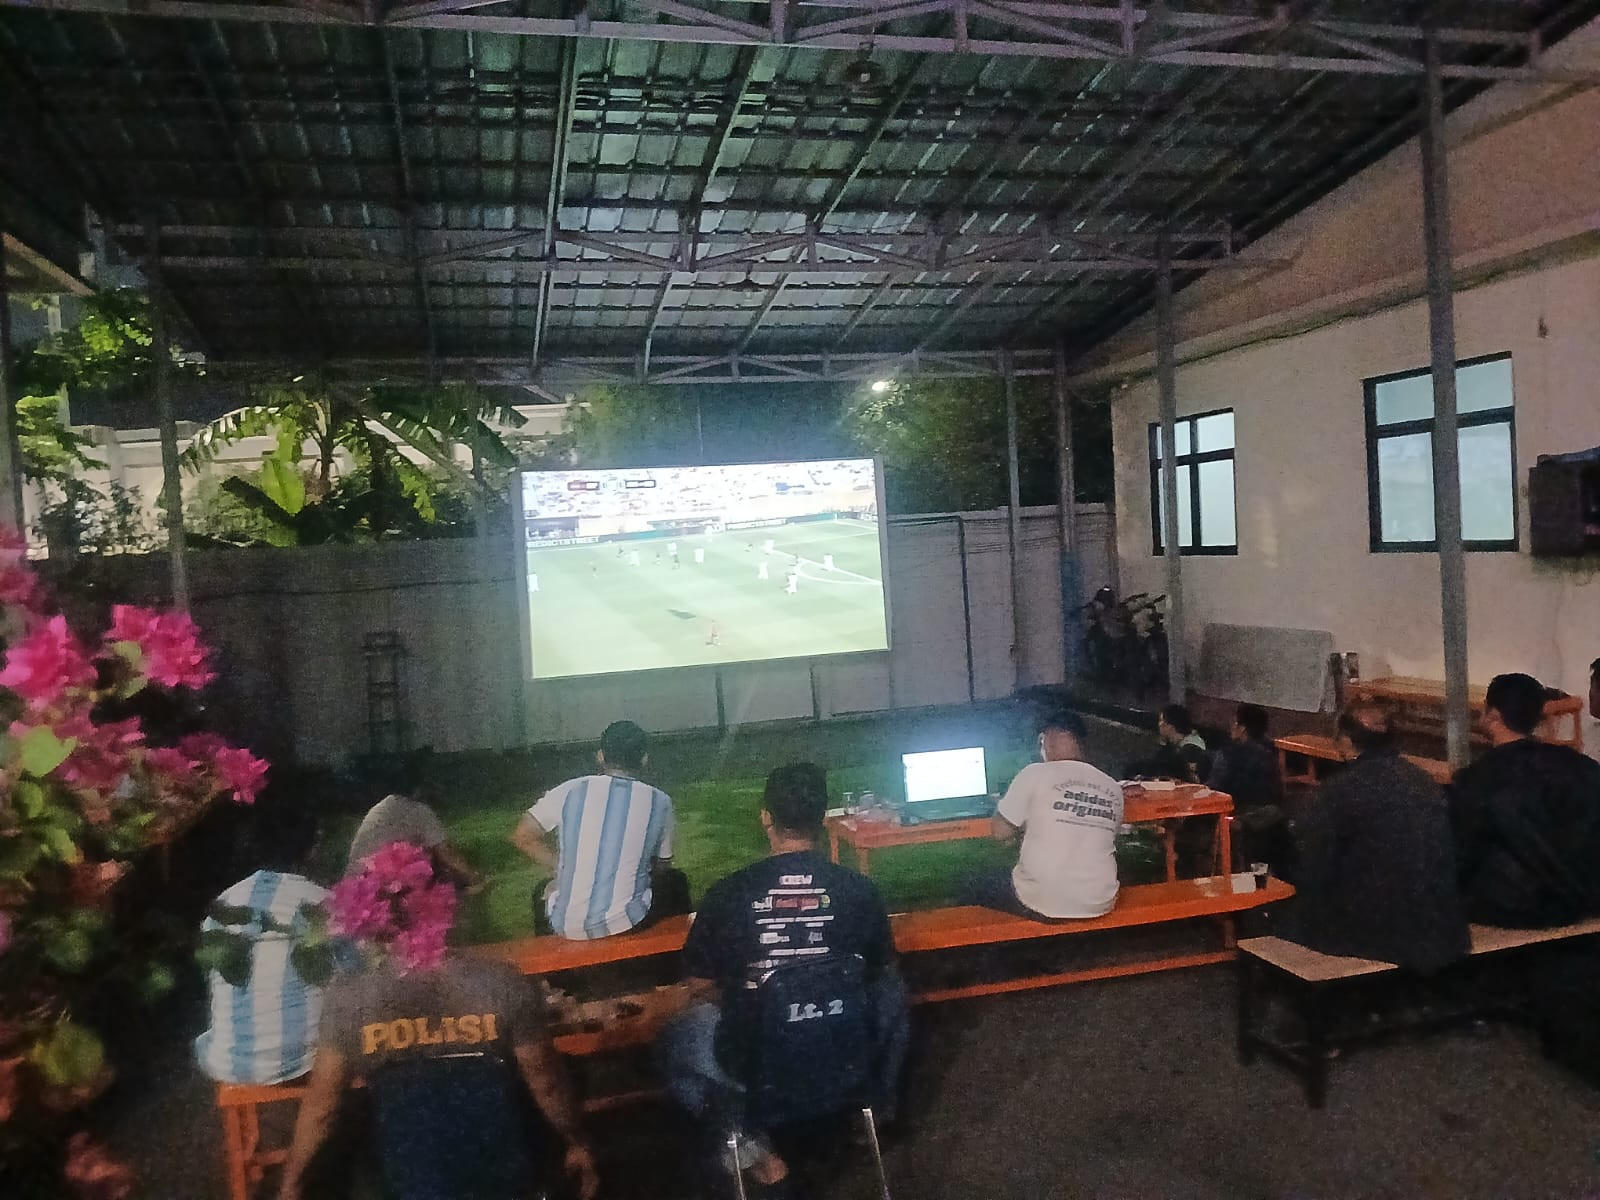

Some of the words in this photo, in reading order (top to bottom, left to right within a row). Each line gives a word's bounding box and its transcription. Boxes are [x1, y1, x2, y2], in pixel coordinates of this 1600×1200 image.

[1063, 790, 1113, 808] adidas
[828, 999, 844, 1015] 2
[363, 1013, 499, 1056] POLISI
